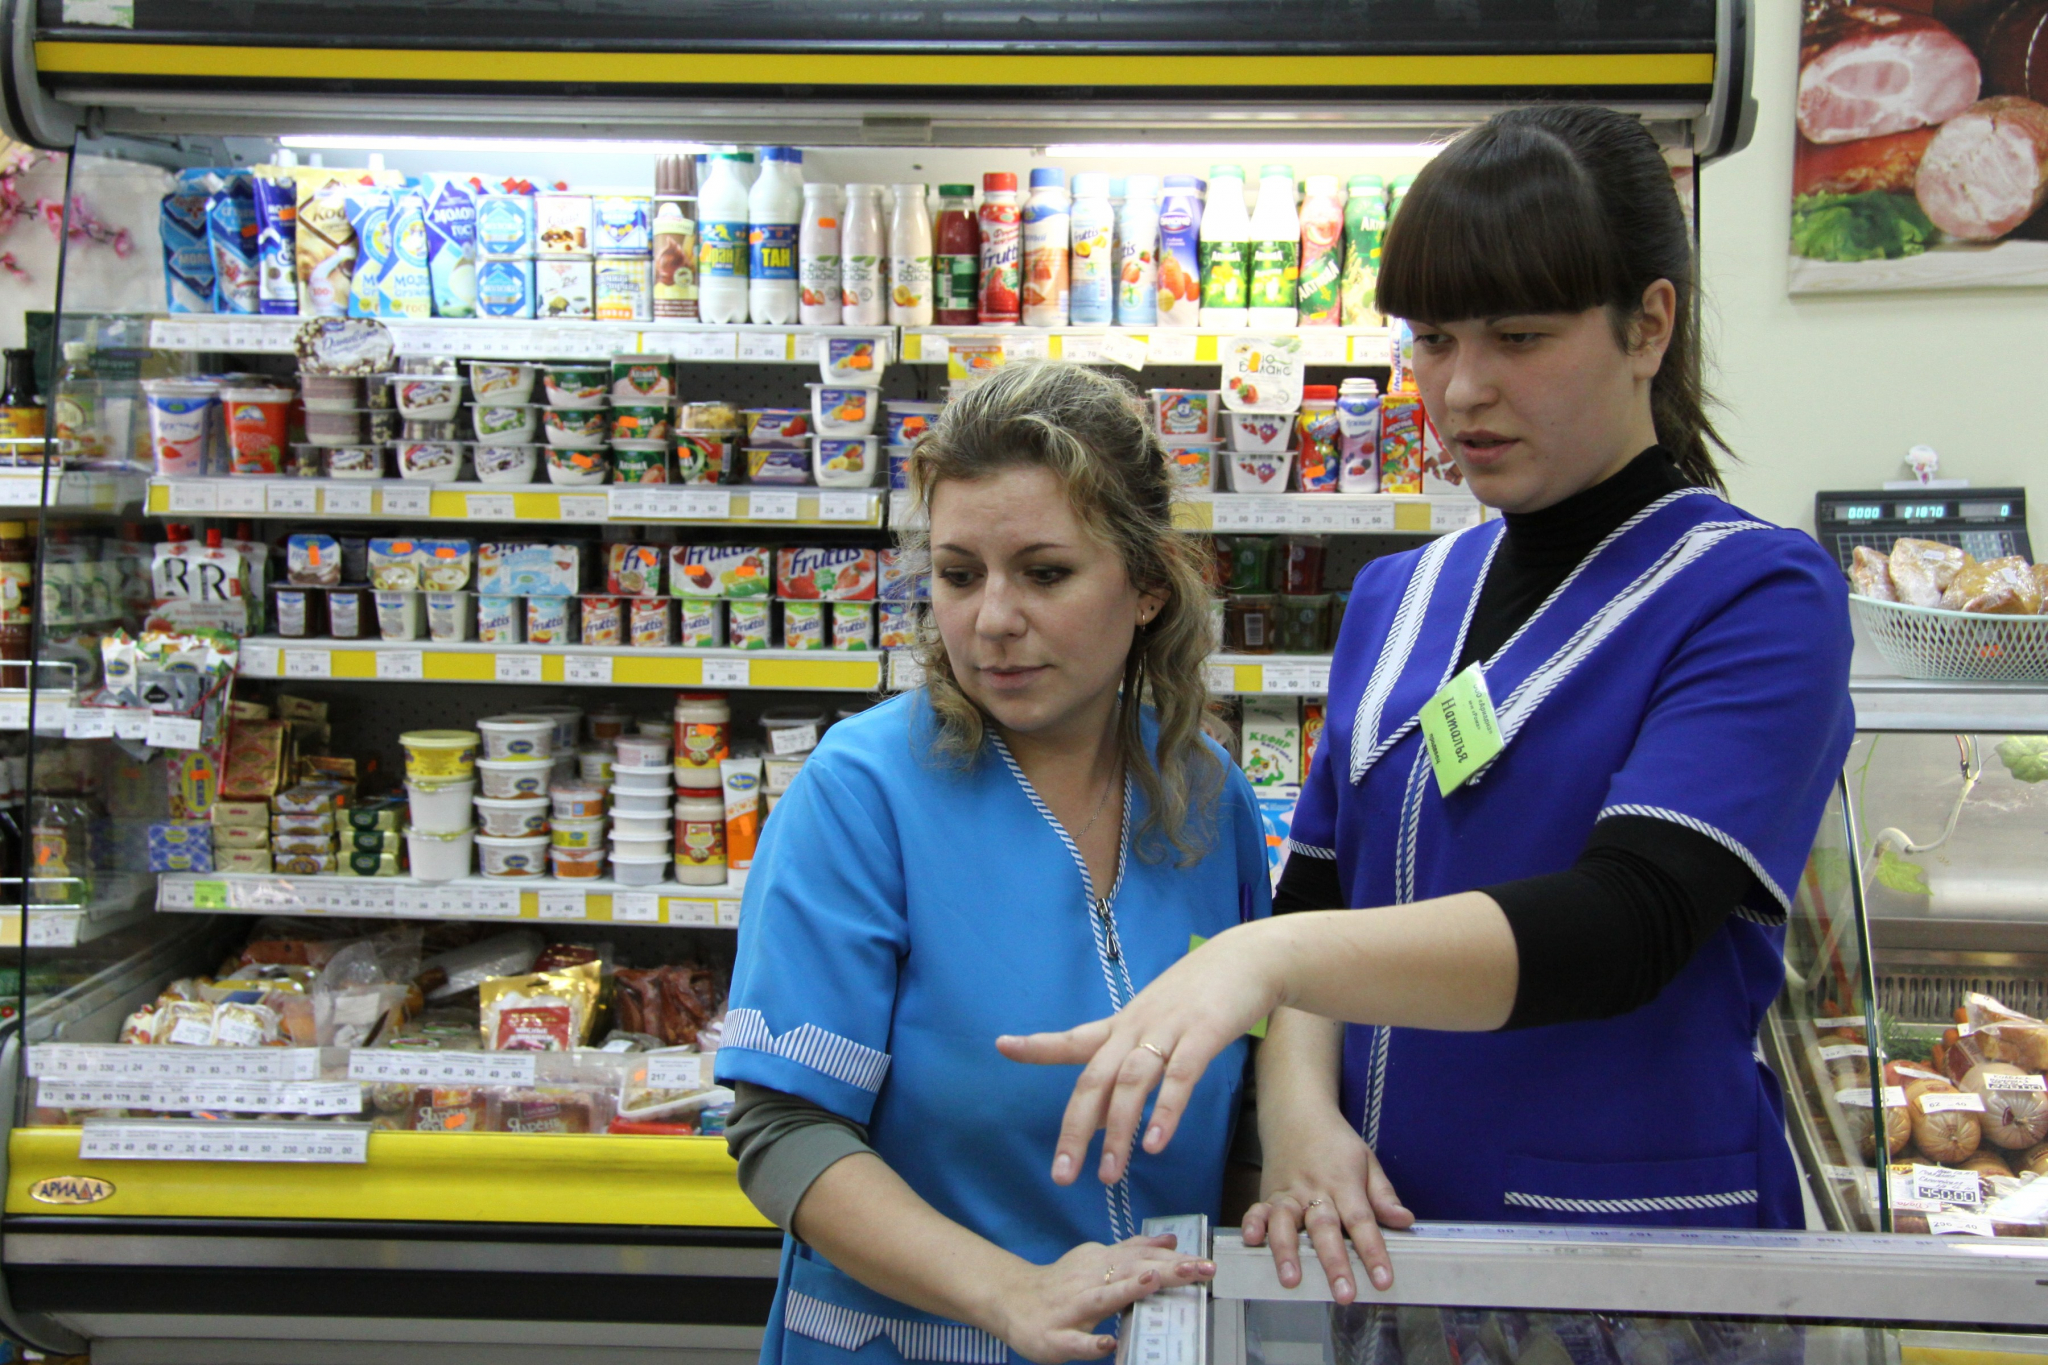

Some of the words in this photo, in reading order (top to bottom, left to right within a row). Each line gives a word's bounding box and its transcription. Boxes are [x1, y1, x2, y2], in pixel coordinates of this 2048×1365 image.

[761, 247, 791, 268] ТАН
[2000, 504, 2010, 517] 0
[1311, 680, 1321, 688] 12
[1441, 696, 1469, 764] Наталья
[1248, 730, 1292, 750] КЕФИР
[1428, 732, 1442, 765] продавец
[464, 1068, 475, 1077] 90
[510, 1070, 522, 1079] 00
[650, 1072, 666, 1081] 217
[675, 1073, 687, 1082] 40
[195, 1095, 205, 1103] 12
[314, 1099, 325, 1107] 94
[336, 1098, 348, 1106] 00
[282, 1145, 298, 1154] 230
[317, 1146, 333, 1155] 230
[341, 1146, 353, 1155] 00
[39, 1180, 104, 1201] АРИАДА
